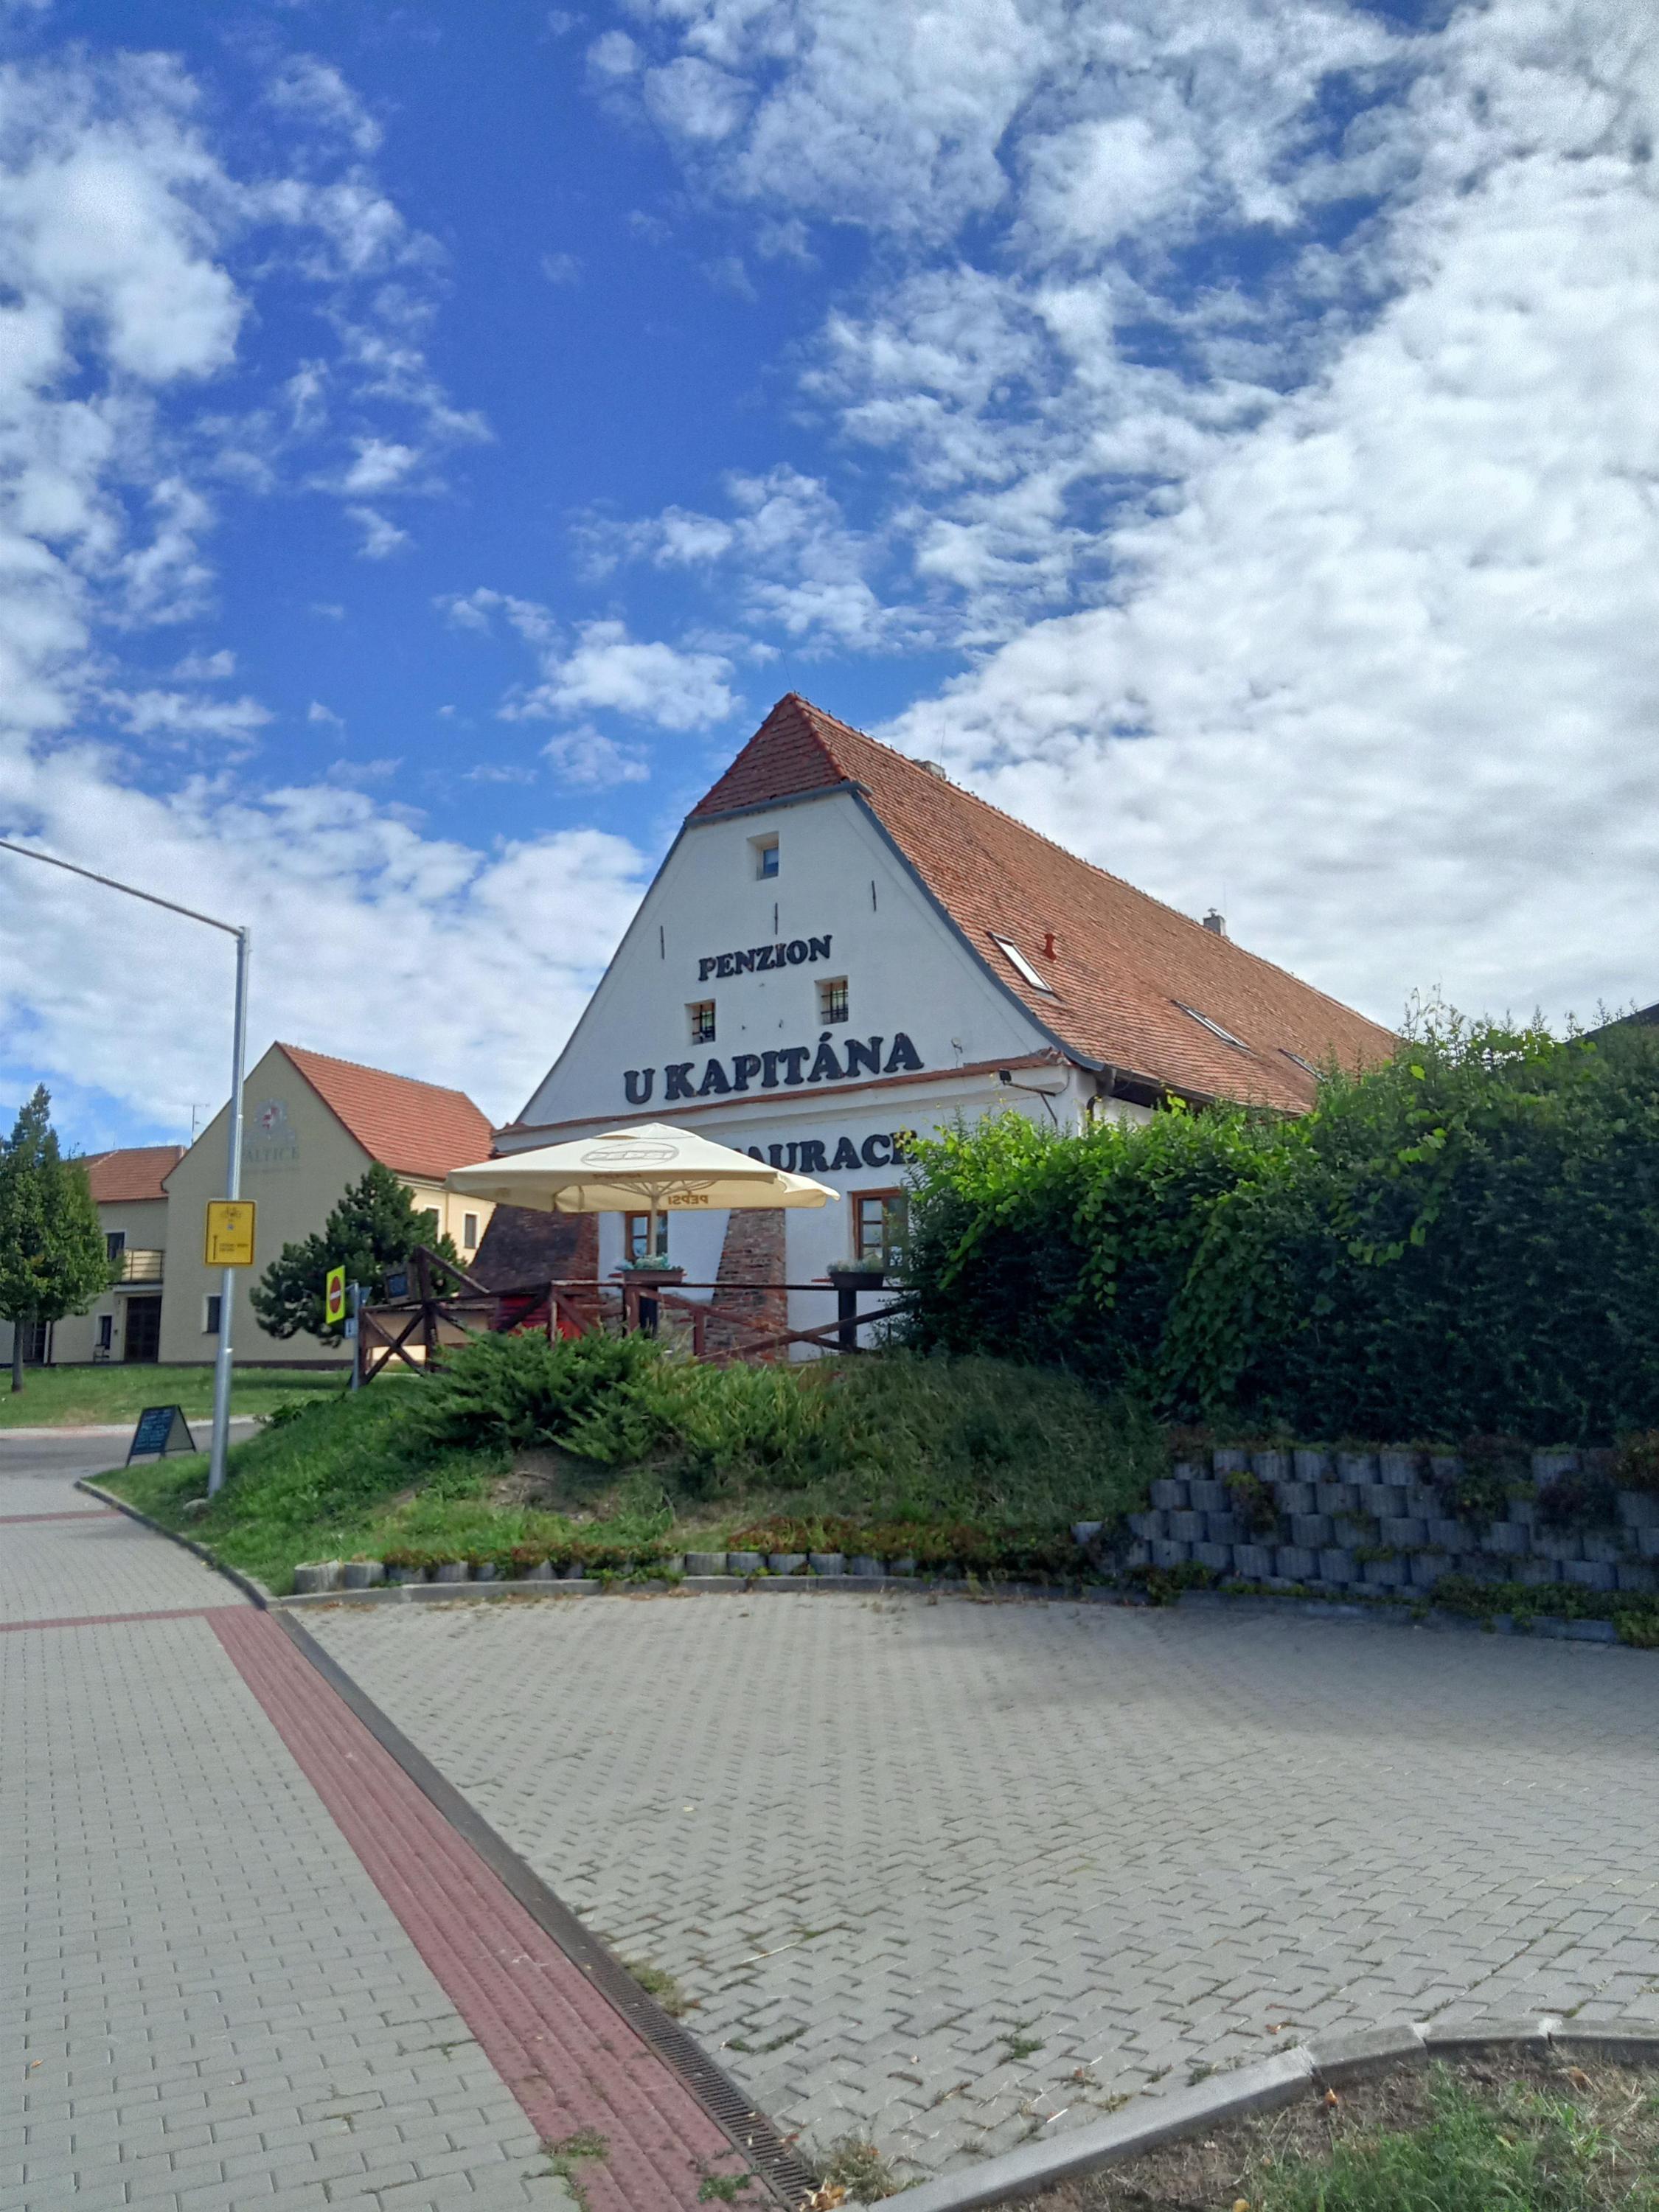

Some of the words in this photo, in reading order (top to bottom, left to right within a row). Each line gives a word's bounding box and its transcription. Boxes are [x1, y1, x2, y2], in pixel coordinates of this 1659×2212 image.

[698, 935, 832, 981] PENZION
[623, 1068, 655, 1105] U
[664, 1032, 925, 1100] KAPITÁNA
